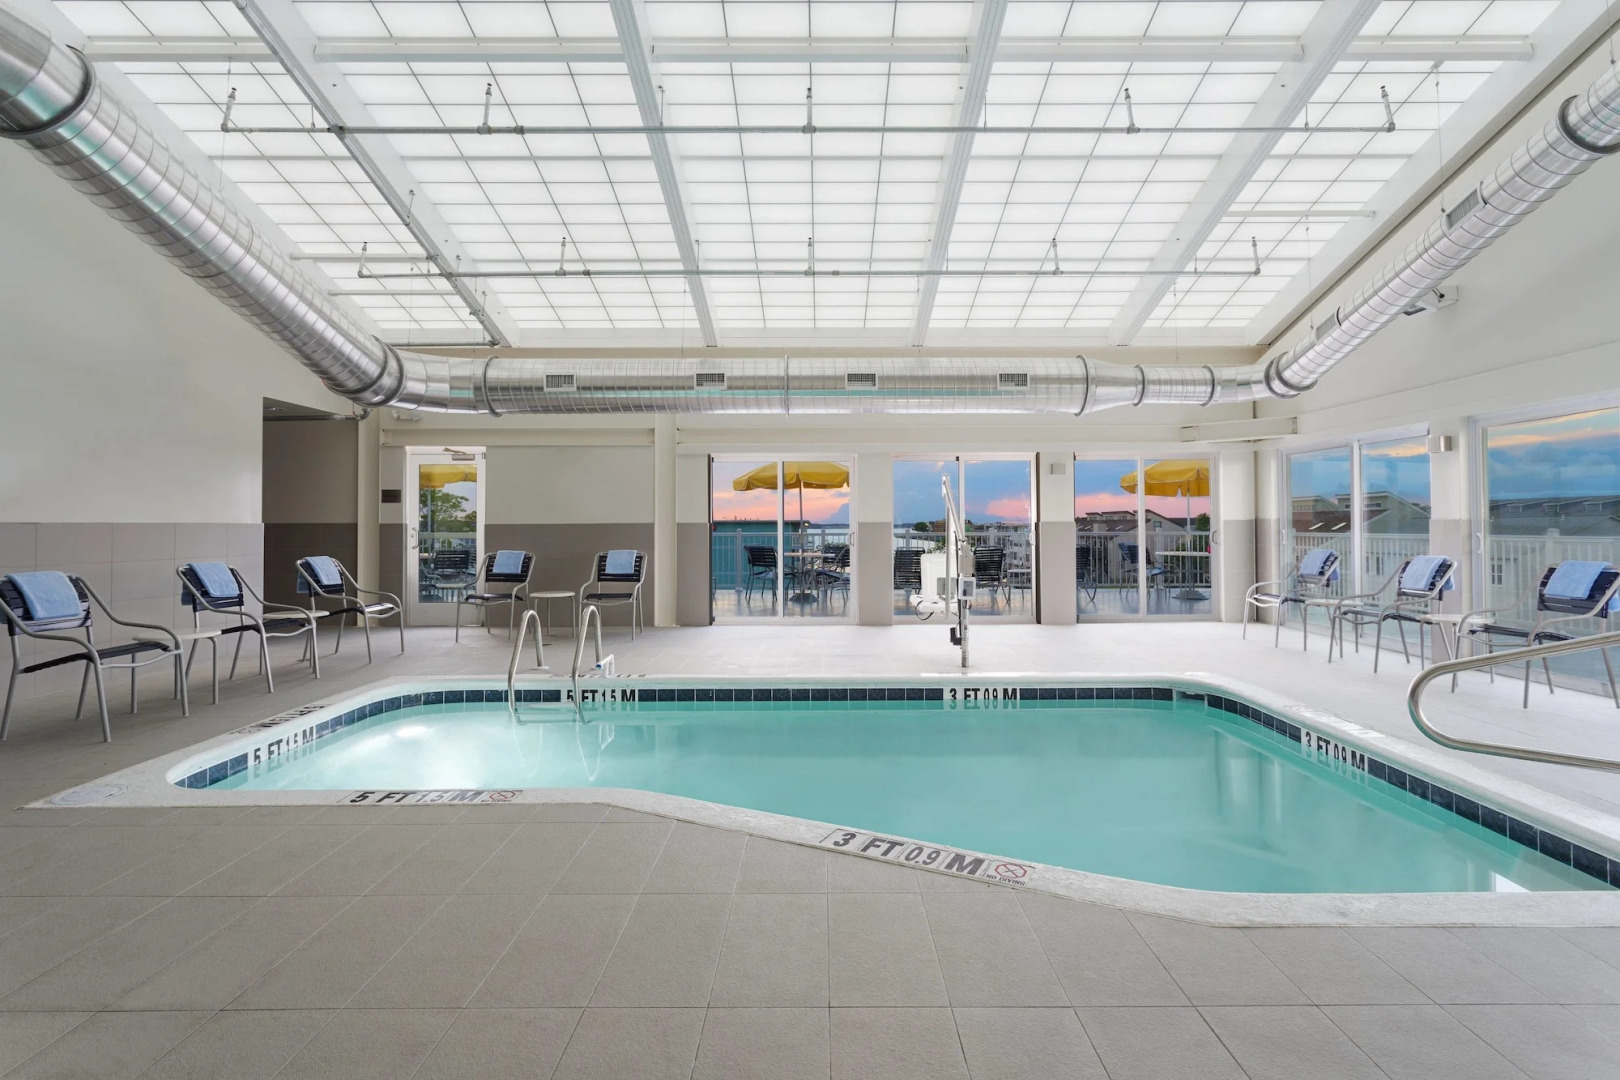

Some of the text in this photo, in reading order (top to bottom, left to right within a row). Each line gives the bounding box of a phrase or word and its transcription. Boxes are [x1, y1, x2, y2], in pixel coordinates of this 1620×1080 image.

[621, 688, 636, 702] M
[949, 688, 957, 700] 3
[1003, 688, 1018, 700] M
[254, 747, 261, 766] 5
[268, 738, 284, 760] FT
[302, 726, 314, 745] M
[1306, 730, 1312, 748] 3
[1316, 735, 1330, 756] FT
[1350, 750, 1366, 772] M
[350, 792, 376, 803] 5
[376, 792, 416, 803] FT
[447, 790, 485, 802] M
[833, 832, 986, 876] 3 FT 0.9 M
[998, 877, 1026, 886] DIVING
